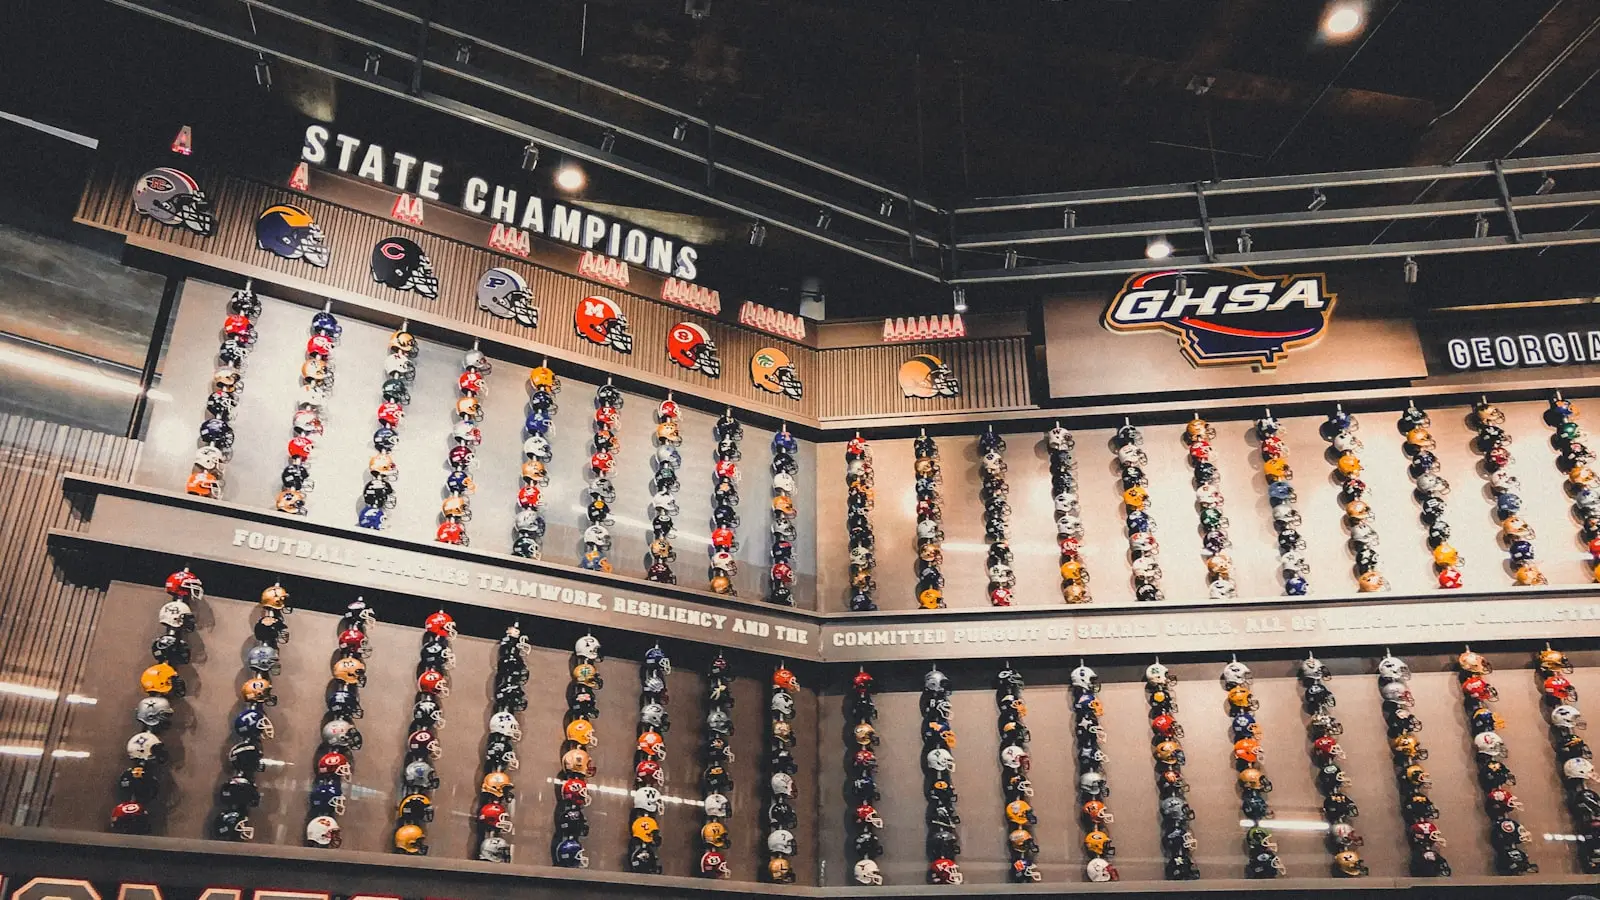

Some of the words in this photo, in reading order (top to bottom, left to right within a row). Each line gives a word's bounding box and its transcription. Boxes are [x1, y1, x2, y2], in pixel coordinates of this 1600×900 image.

[171, 125, 193, 156] A
[288, 161, 309, 191] A
[302, 124, 443, 200] STATE
[463, 177, 698, 280] CHAMPIONS
[391, 193, 425, 226] AA
[380, 242, 405, 261] C
[488, 223, 532, 257] AAA
[483, 275, 506, 290] P
[577, 250, 631, 287] AAAA
[584, 300, 605, 318] M
[661, 276, 722, 315] AAAAA
[1113, 278, 1325, 321] GHSA
[738, 300, 807, 341] AAAAAA
[883, 313, 966, 343] AAAAAAA
[232, 527, 360, 569] FOOTBALL
[477, 571, 607, 612] TEAMWORK,
[613, 596, 728, 631] RESILIENCY
[731, 616, 770, 639] AND
[775, 624, 809, 645] THE
[832, 628, 947, 648] COMMITTED
[954, 626, 1040, 644] PURSUIT
[1047, 624, 1073, 642] OF
[1243, 615, 1286, 634] ALL
